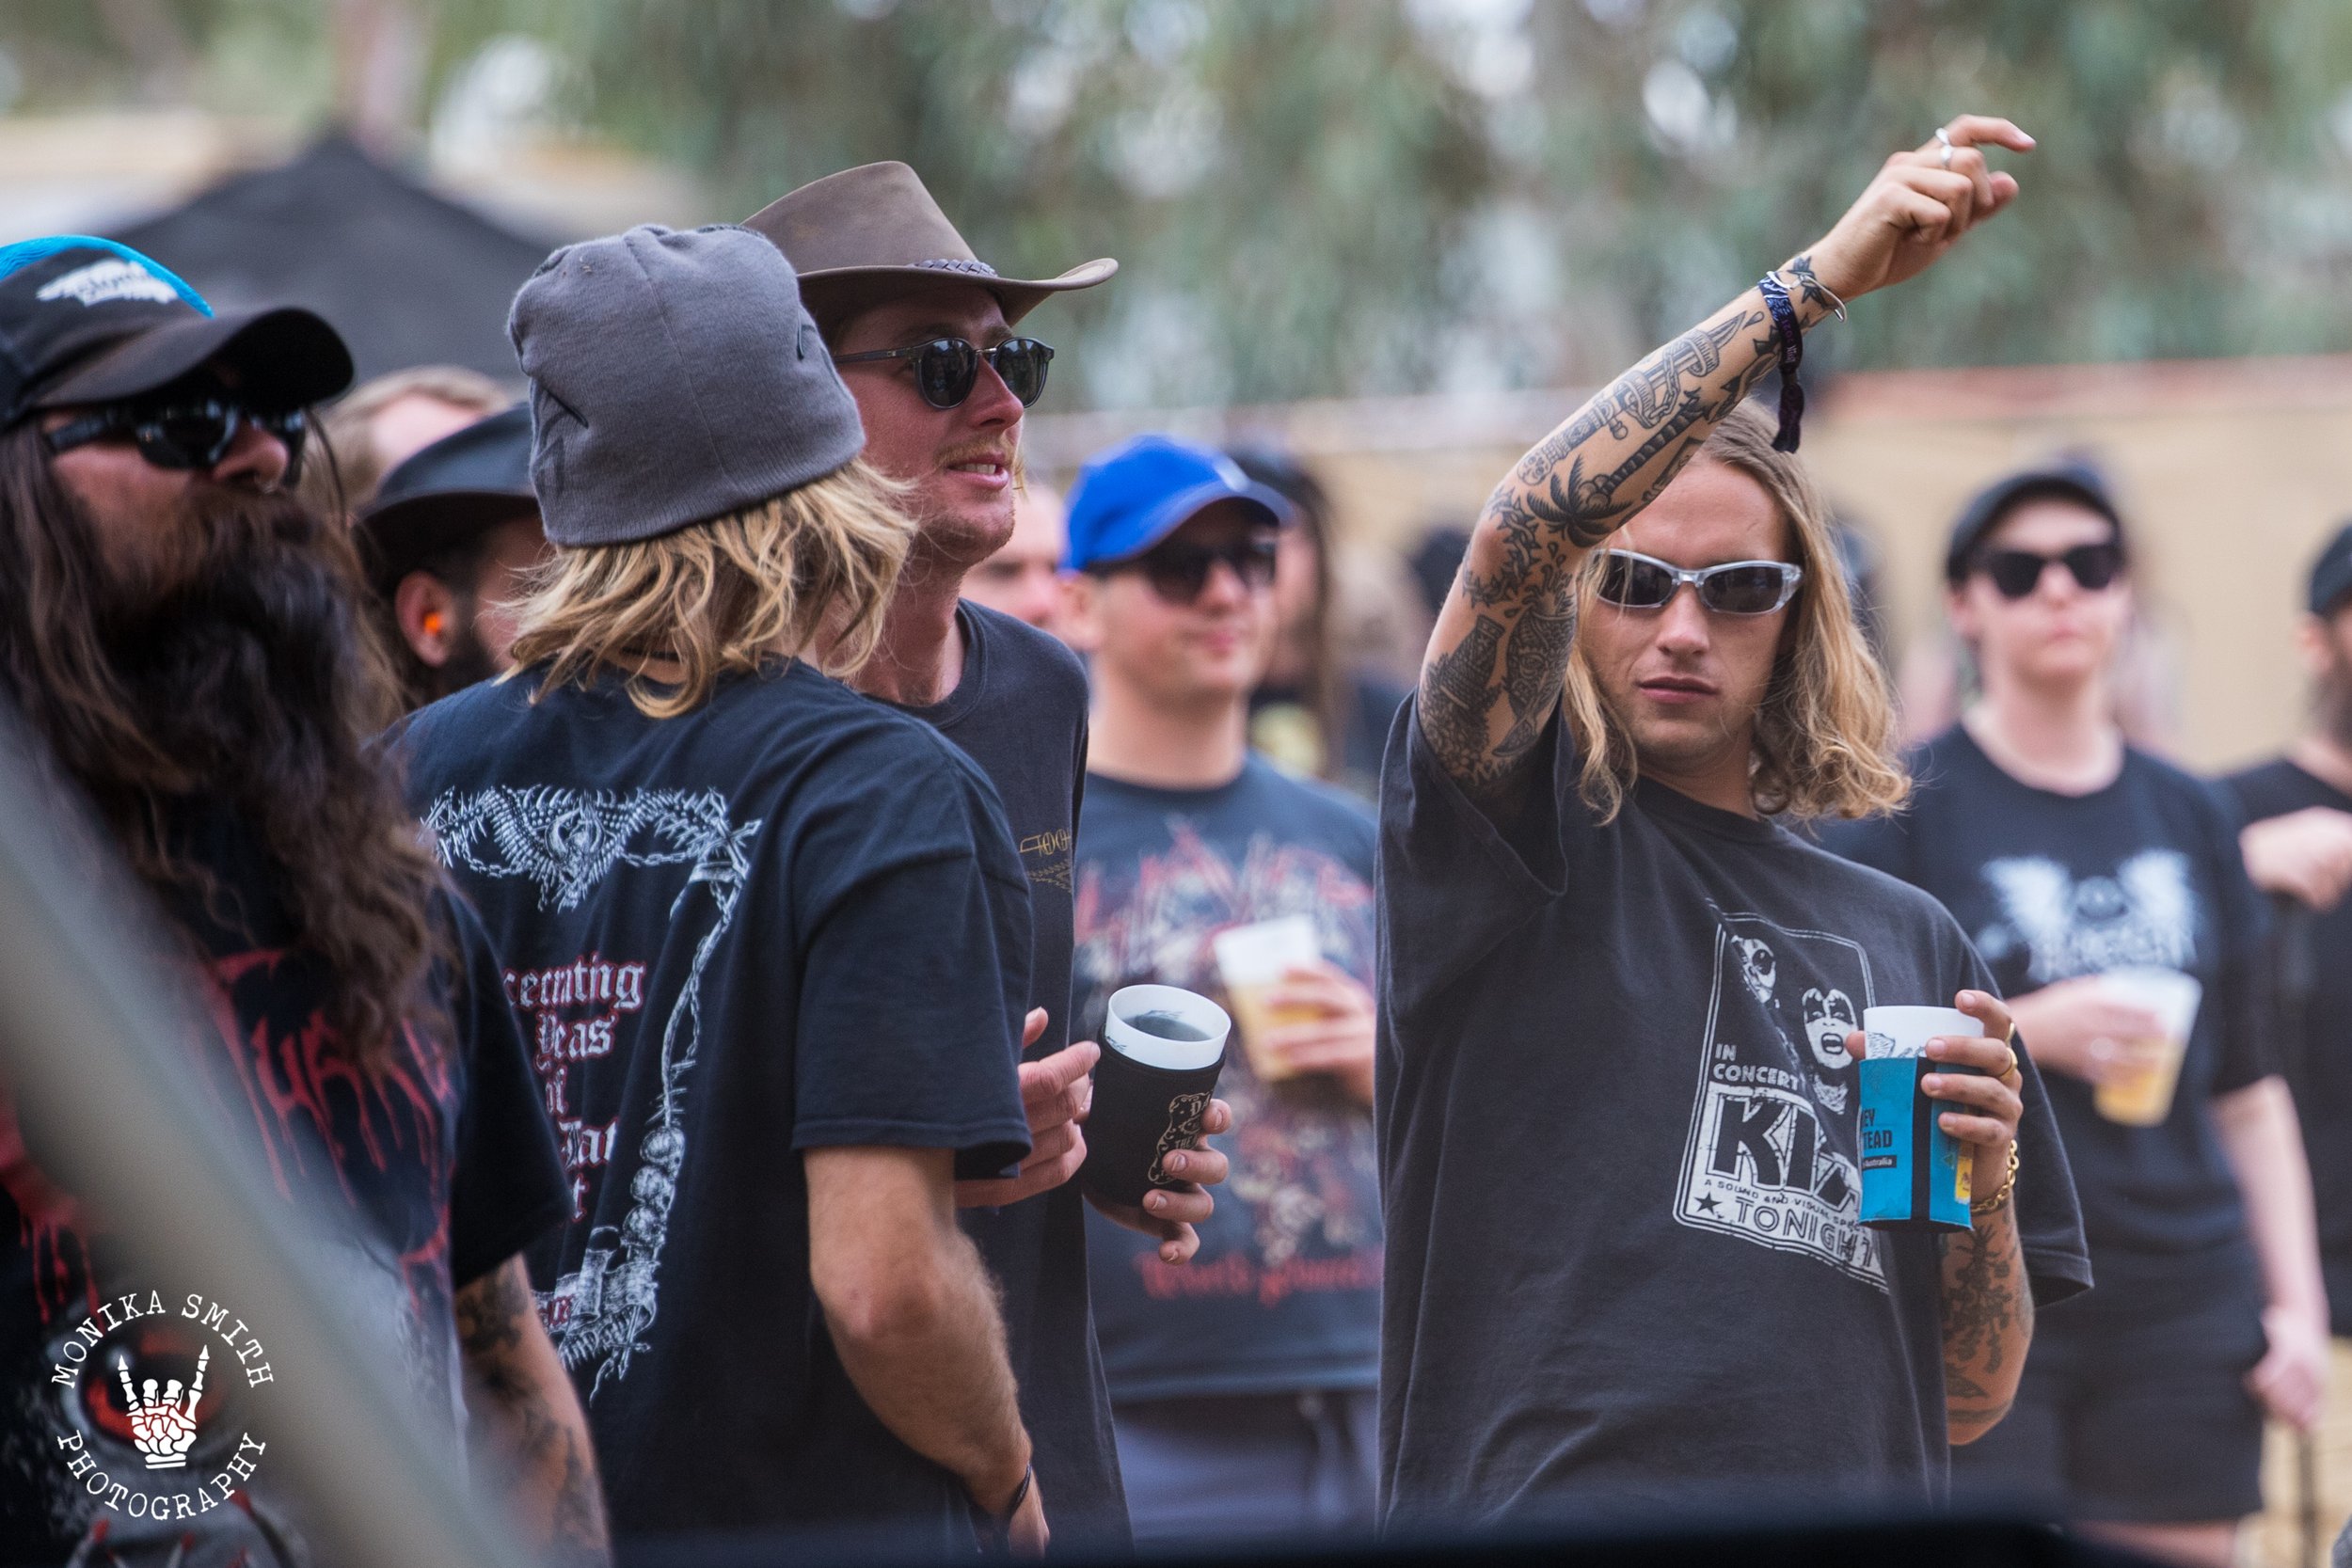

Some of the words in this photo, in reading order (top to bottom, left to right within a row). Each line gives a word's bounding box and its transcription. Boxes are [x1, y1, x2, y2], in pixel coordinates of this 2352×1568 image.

[1714, 1042, 1737, 1061] IN
[1712, 1062, 1800, 1091] CONCERT
[1704, 1179, 1713, 1187] A
[1717, 1180, 1759, 1199] SOUND
[1763, 1193, 1790, 1206] AND
[1793, 1196, 1830, 1220] VISUAL
[1734, 1195, 1873, 1269] TONIGHT
